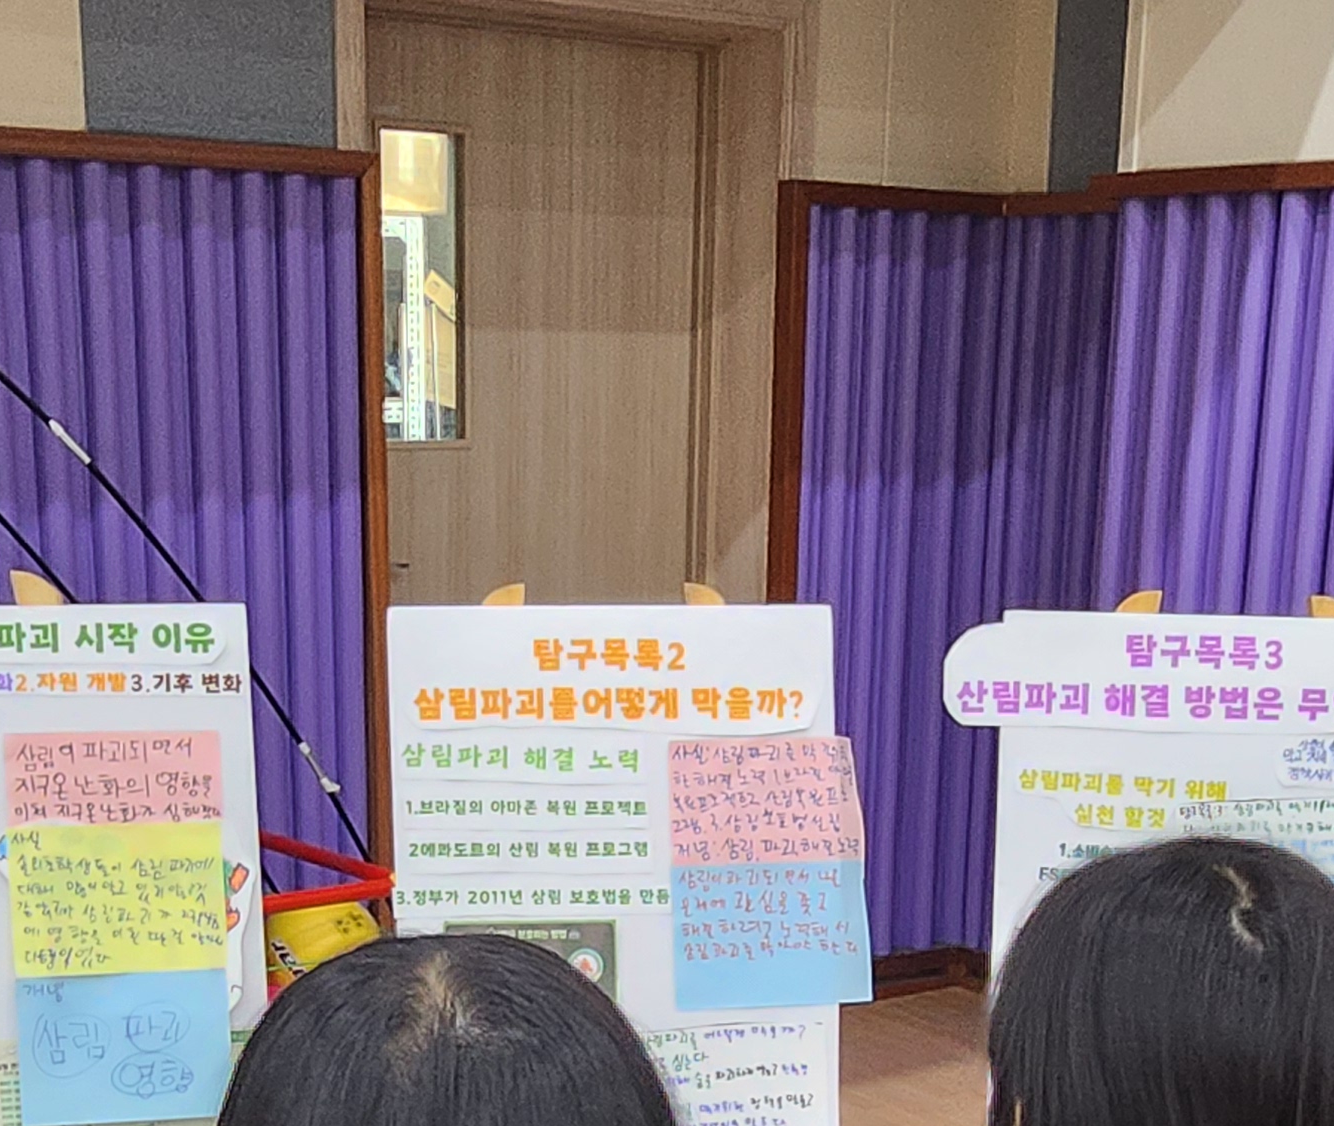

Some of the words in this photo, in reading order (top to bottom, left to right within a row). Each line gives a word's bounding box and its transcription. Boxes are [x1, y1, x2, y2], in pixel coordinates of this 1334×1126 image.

[74, 621, 139, 654] 시작
[151, 621, 216, 655] 이유
[1125, 633, 1285, 671] 탐구목록3
[532, 637, 687, 672] 탐구목록2
[86, 673, 127, 693] 개발
[130, 672, 193, 693] 3.기후
[201, 672, 243, 694] 변화
[690, 686, 805, 721] 막을까?
[956, 680, 1091, 718] 산림파괴
[1103, 683, 1170, 719] 해결
[1183, 684, 1285, 722] 방법은
[523, 745, 576, 773] 해결
[588, 746, 640, 774] 노력
[1133, 770, 1175, 799] 막기
[1183, 777, 1228, 802] 위해
[405, 799, 484, 817] 1.브라질의
[490, 799, 538, 817] 아마존
[546, 799, 578, 817] 복원
[584, 800, 648, 817] 프로젝트
[547, 842, 578, 859] 복원
[396, 888, 460, 907] 3.정부가
[466, 888, 524, 907] 2011년
[569, 888, 633, 906] 보호법을
